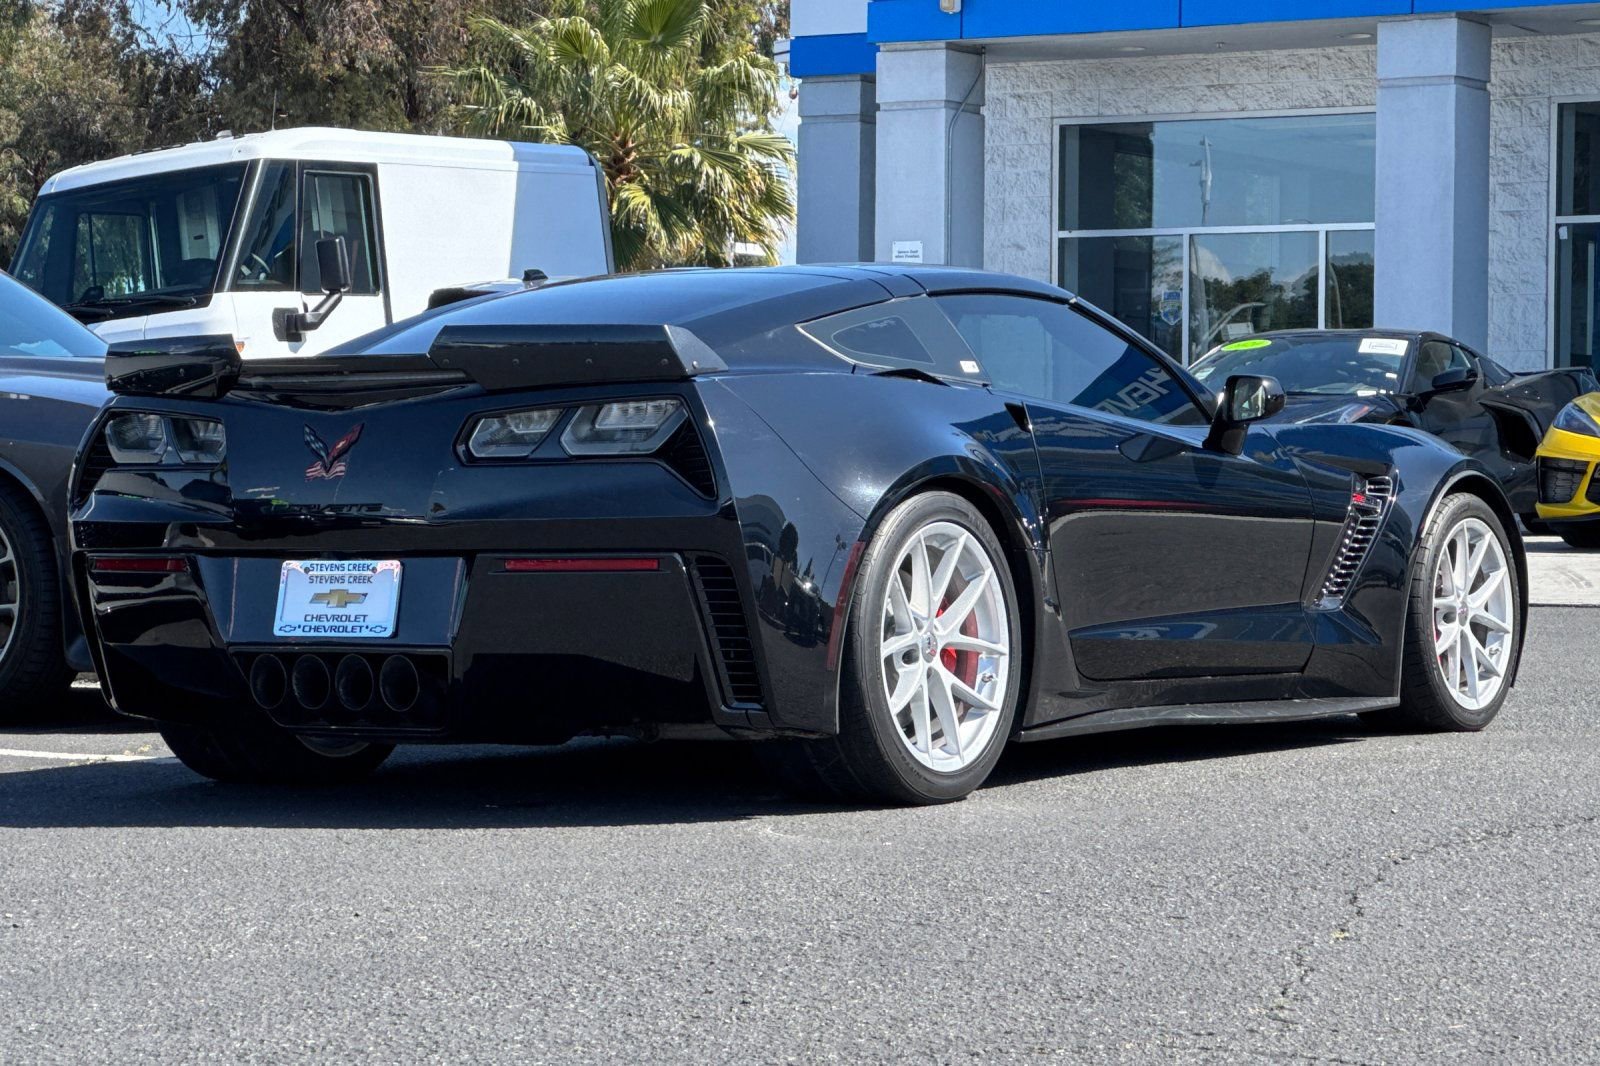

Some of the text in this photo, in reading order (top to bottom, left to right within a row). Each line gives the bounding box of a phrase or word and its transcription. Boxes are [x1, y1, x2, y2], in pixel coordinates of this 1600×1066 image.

[309, 563, 372, 572] STEVENS CREEK
[308, 575, 373, 584] STEVENS CREEK
[304, 614, 368, 623] CHEVROLET
[302, 625, 363, 633] CHEVROLET
